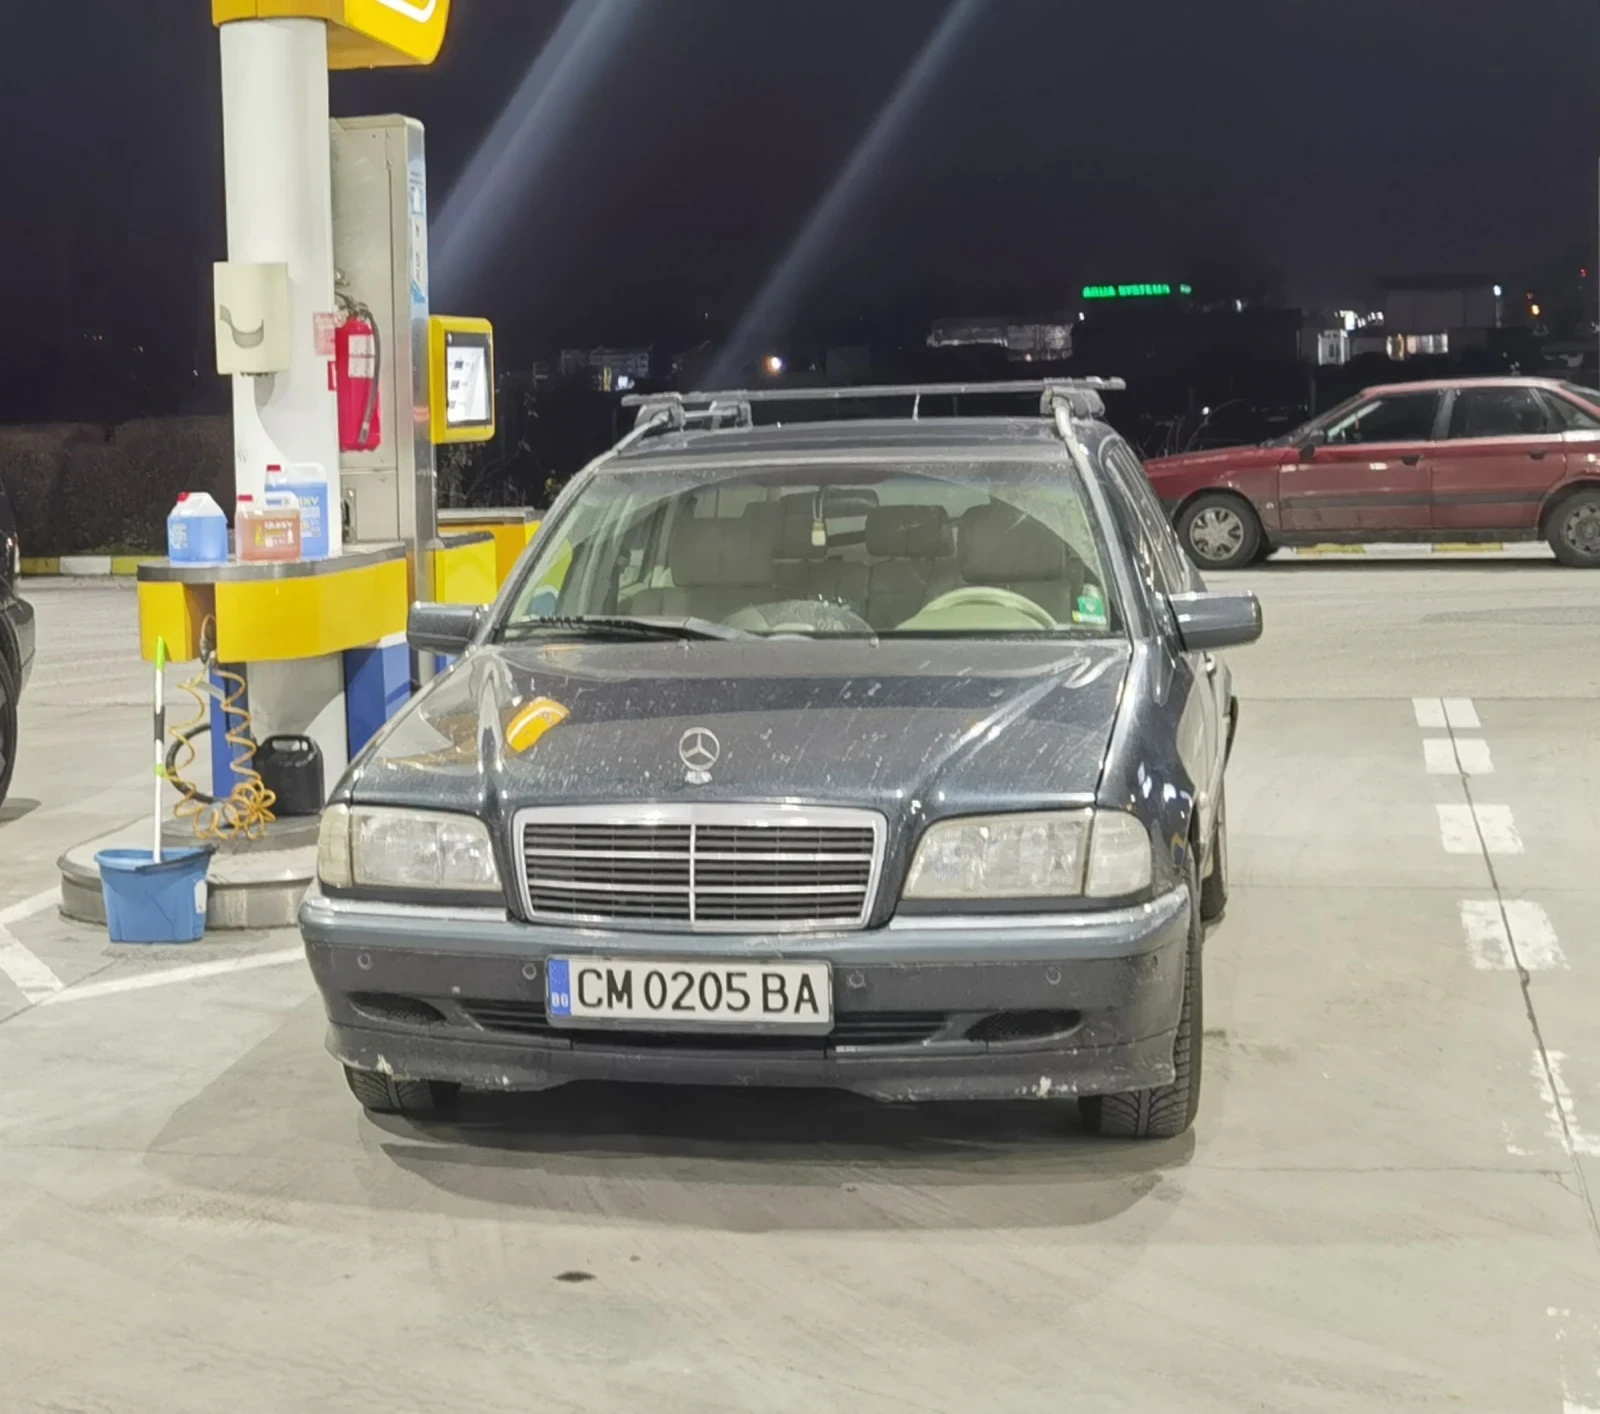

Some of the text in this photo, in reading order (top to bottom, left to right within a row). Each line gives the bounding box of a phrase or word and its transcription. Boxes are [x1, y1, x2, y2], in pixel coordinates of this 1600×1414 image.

[577, 968, 820, 1015] CM 0205 BA
